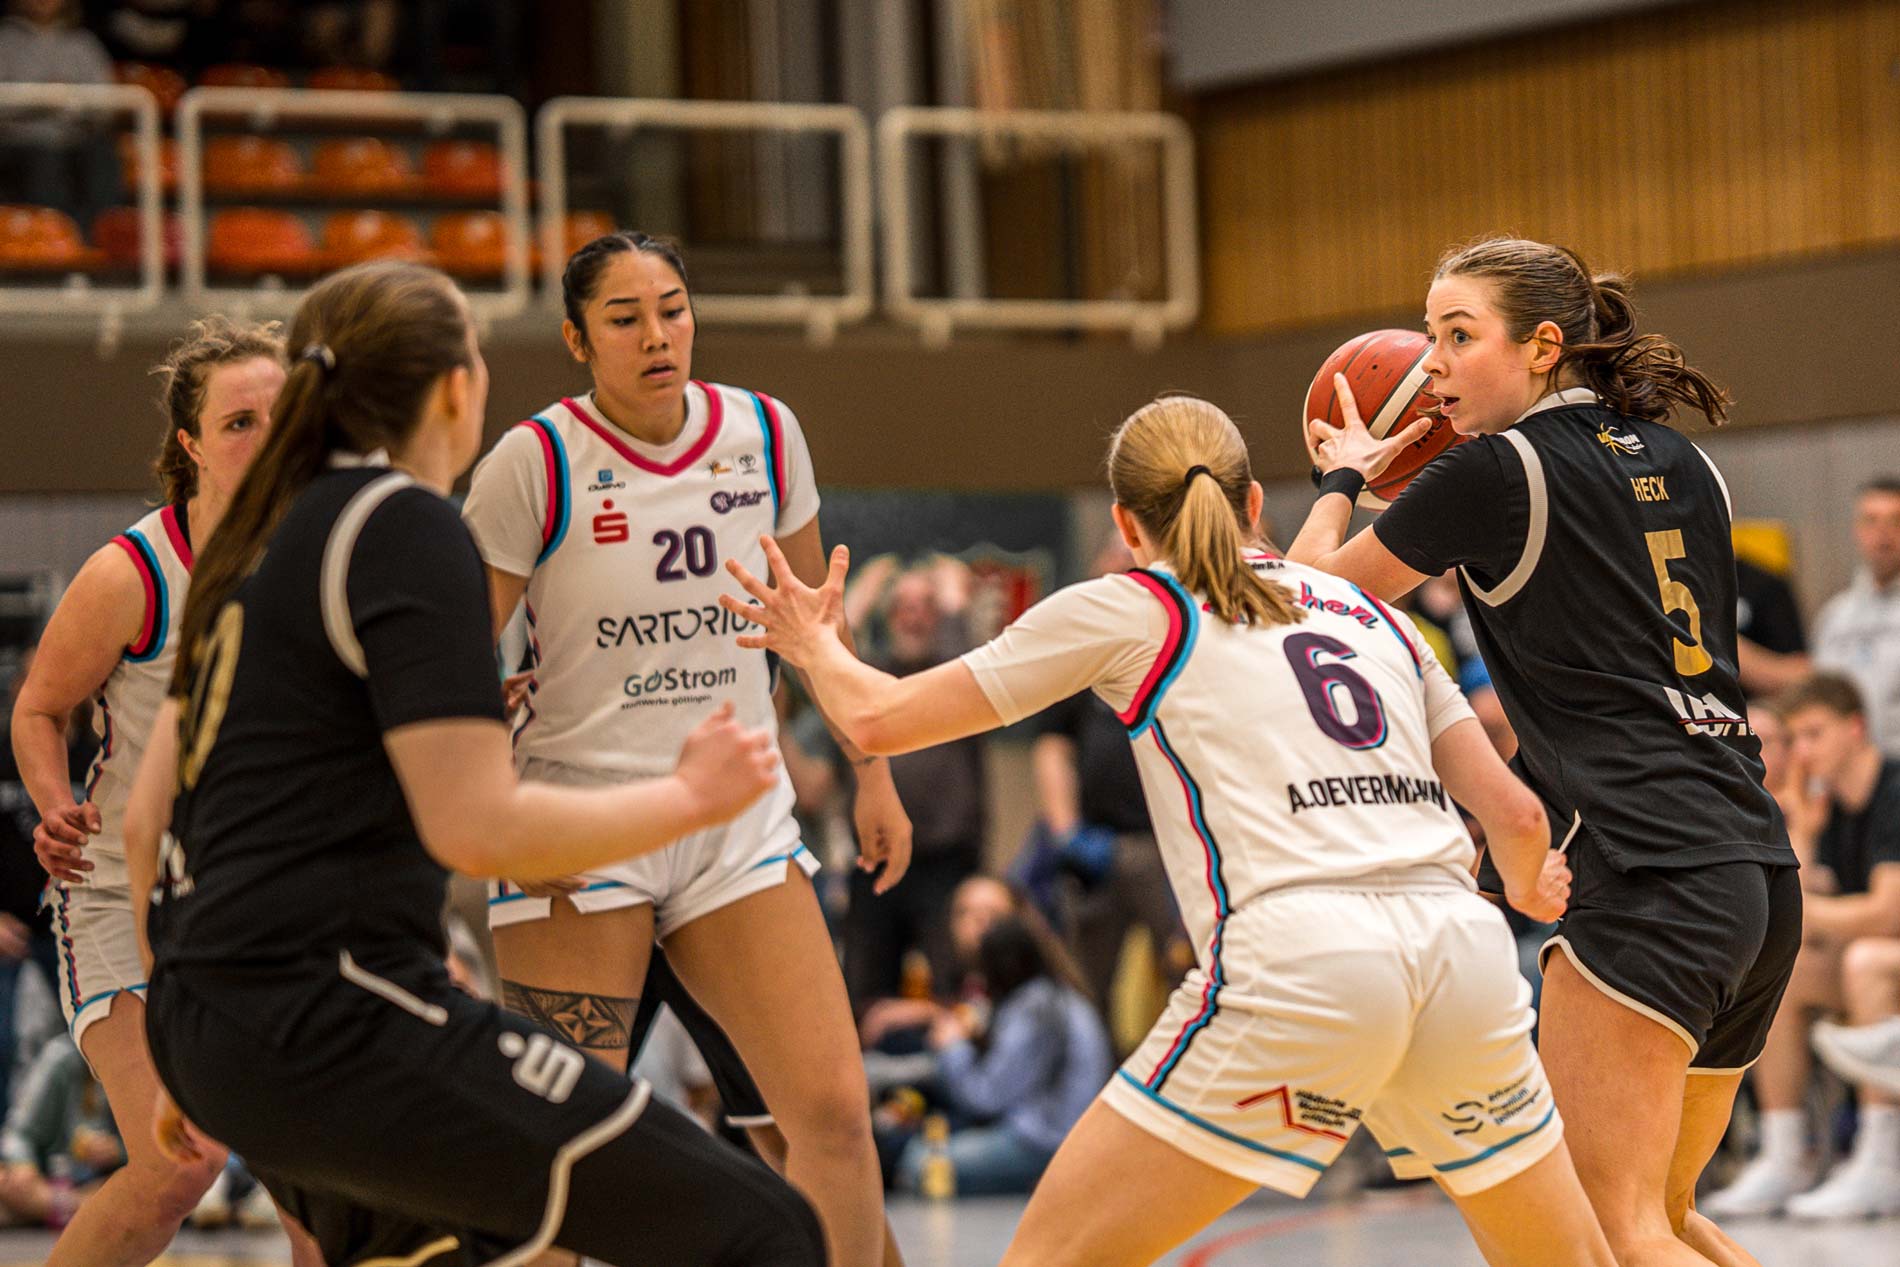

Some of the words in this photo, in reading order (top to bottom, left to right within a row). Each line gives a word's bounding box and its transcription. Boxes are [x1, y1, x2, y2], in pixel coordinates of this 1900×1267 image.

[1630, 476, 1670, 502] HECK
[653, 525, 718, 583] 20
[1645, 529, 1713, 676] 5
[1283, 632, 1388, 751] 6
